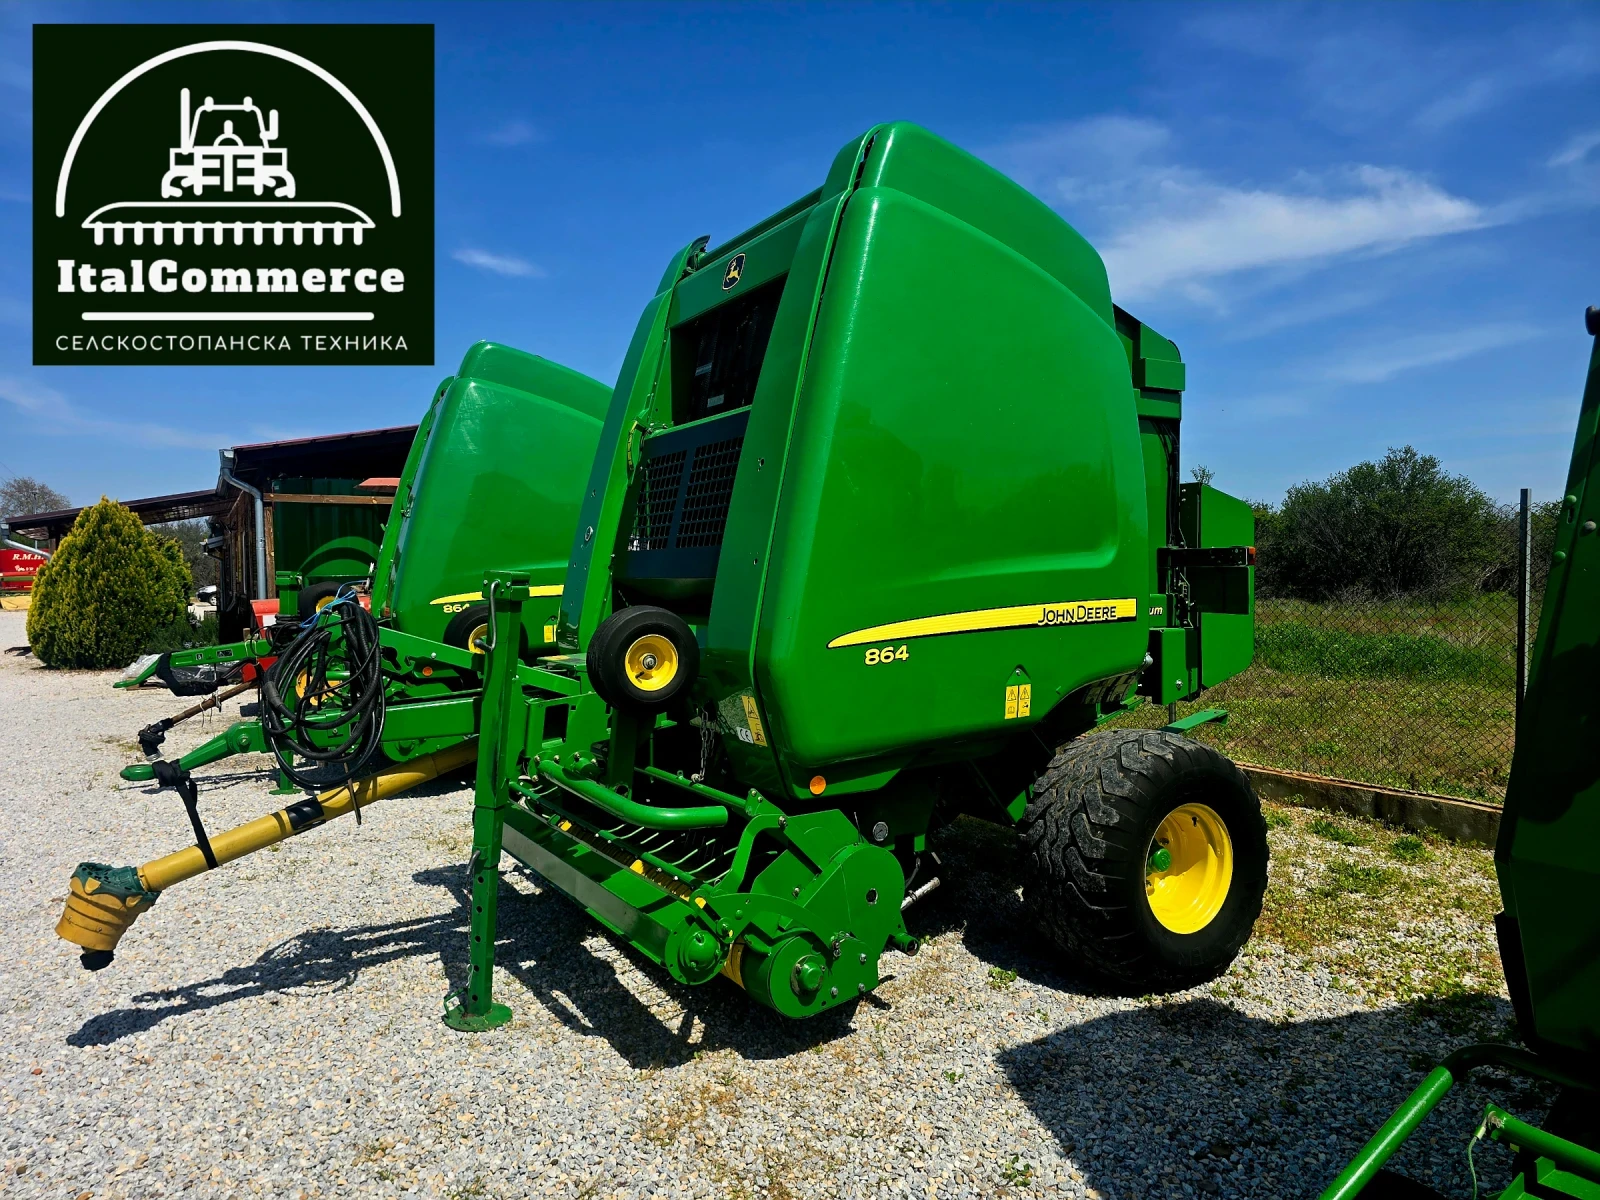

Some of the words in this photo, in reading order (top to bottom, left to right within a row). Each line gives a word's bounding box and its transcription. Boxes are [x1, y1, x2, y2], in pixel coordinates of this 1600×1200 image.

[1038, 607, 1075, 625] JOHN
[1077, 605, 1117, 621] DEERE
[864, 644, 910, 666] 864
